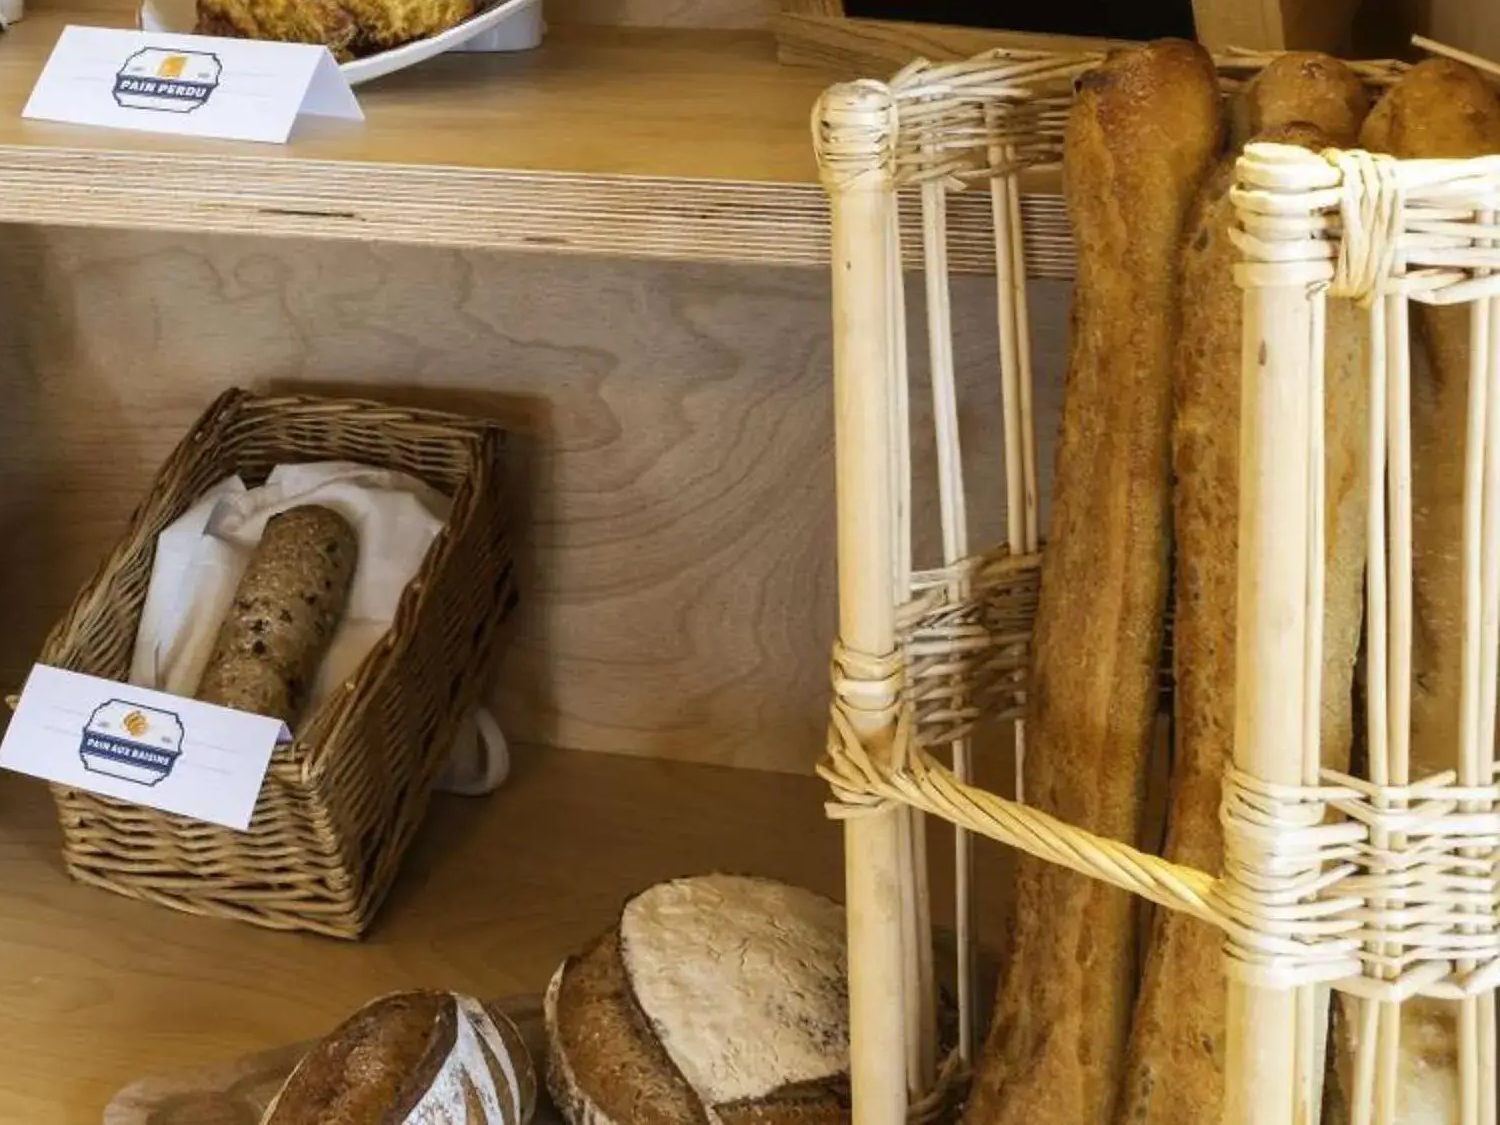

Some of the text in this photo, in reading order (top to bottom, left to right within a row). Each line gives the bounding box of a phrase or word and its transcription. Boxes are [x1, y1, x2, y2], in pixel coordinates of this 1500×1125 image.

[120, 79, 207, 98] PAIN PERDU
[86, 737, 170, 766] PAIN AUX RAISINS
